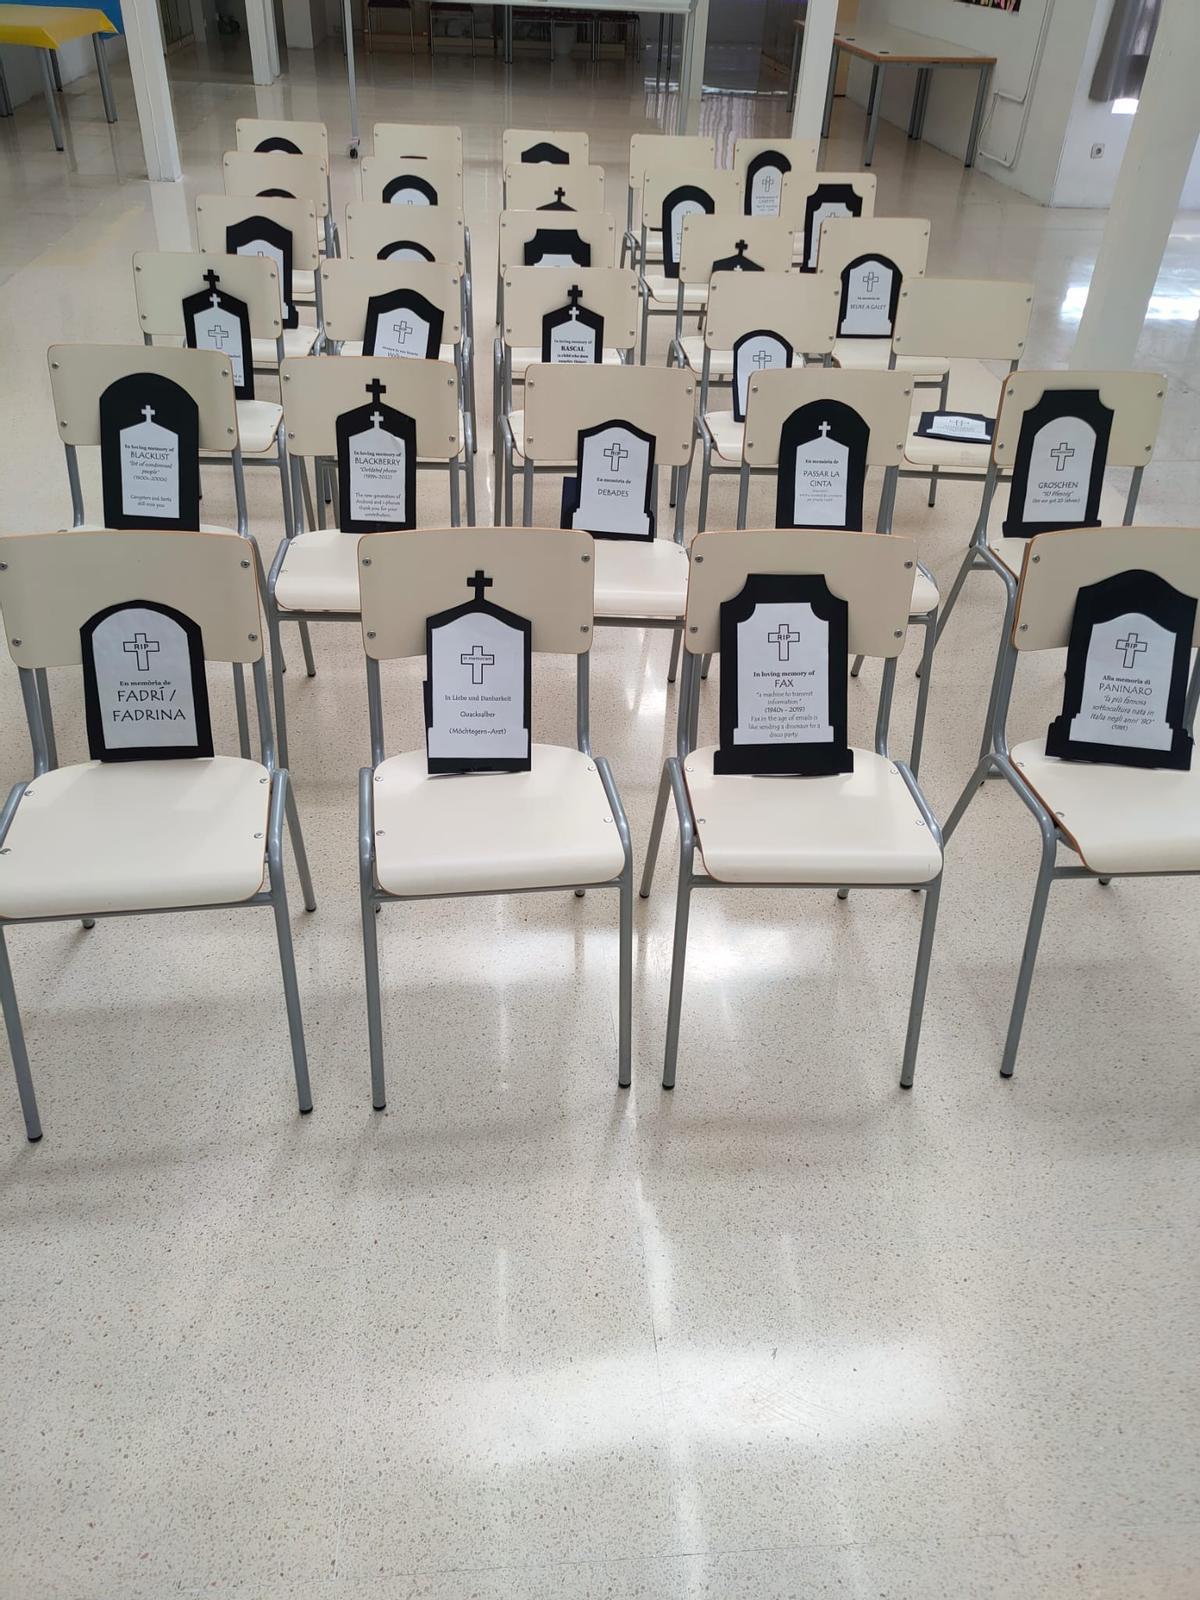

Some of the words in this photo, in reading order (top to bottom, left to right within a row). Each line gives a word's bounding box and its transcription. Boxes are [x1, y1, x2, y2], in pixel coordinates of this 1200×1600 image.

[130, 451, 170, 460] BLACKLIST
[354, 457, 400, 466] BLACKBERRY
[810, 480, 832, 488] CINTA
[1038, 480, 1079, 489] GROSCHEN
[598, 488, 629, 498] DEBADES
[774, 679, 794, 688] FAX
[1098, 682, 1152, 696] PANINARO
[1123, 695, 1146, 706] famosa
[460, 710, 496, 718] Quacksalber
[1092, 704, 1130, 714] sottocultura
[1132, 708, 1146, 716] nata
[113, 708, 186, 722] FADRINA
[1090, 712, 1106, 720] Italia
[1107, 714, 1123, 724] negli
